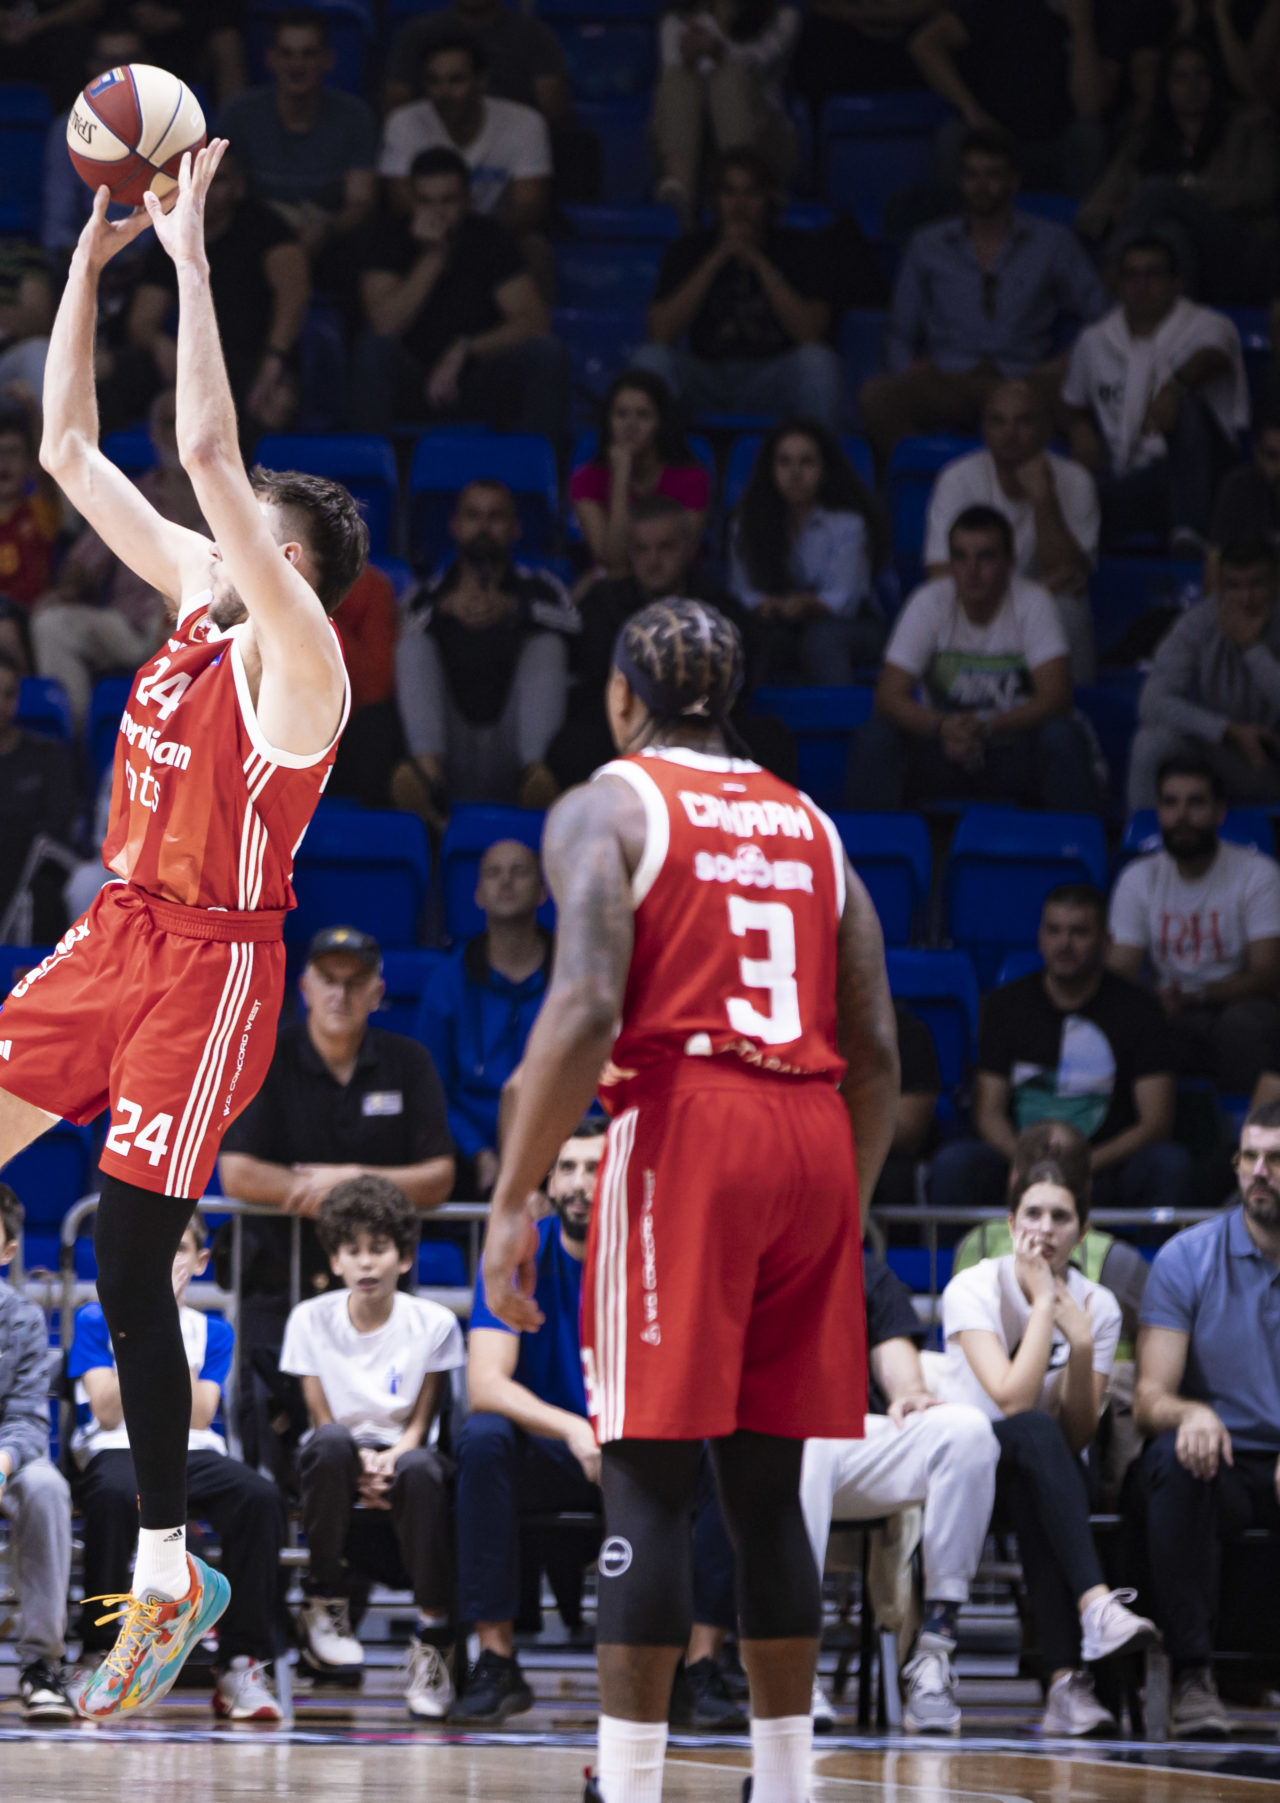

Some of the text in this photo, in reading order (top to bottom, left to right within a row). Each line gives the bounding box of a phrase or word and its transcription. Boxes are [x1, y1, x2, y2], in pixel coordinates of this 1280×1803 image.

[135, 656, 192, 721] 24
[724, 895, 802, 1045] 3
[229, 1033, 249, 1091] CONCORD
[244, 999, 262, 1032] WEST
[106, 1097, 173, 1167] 24
